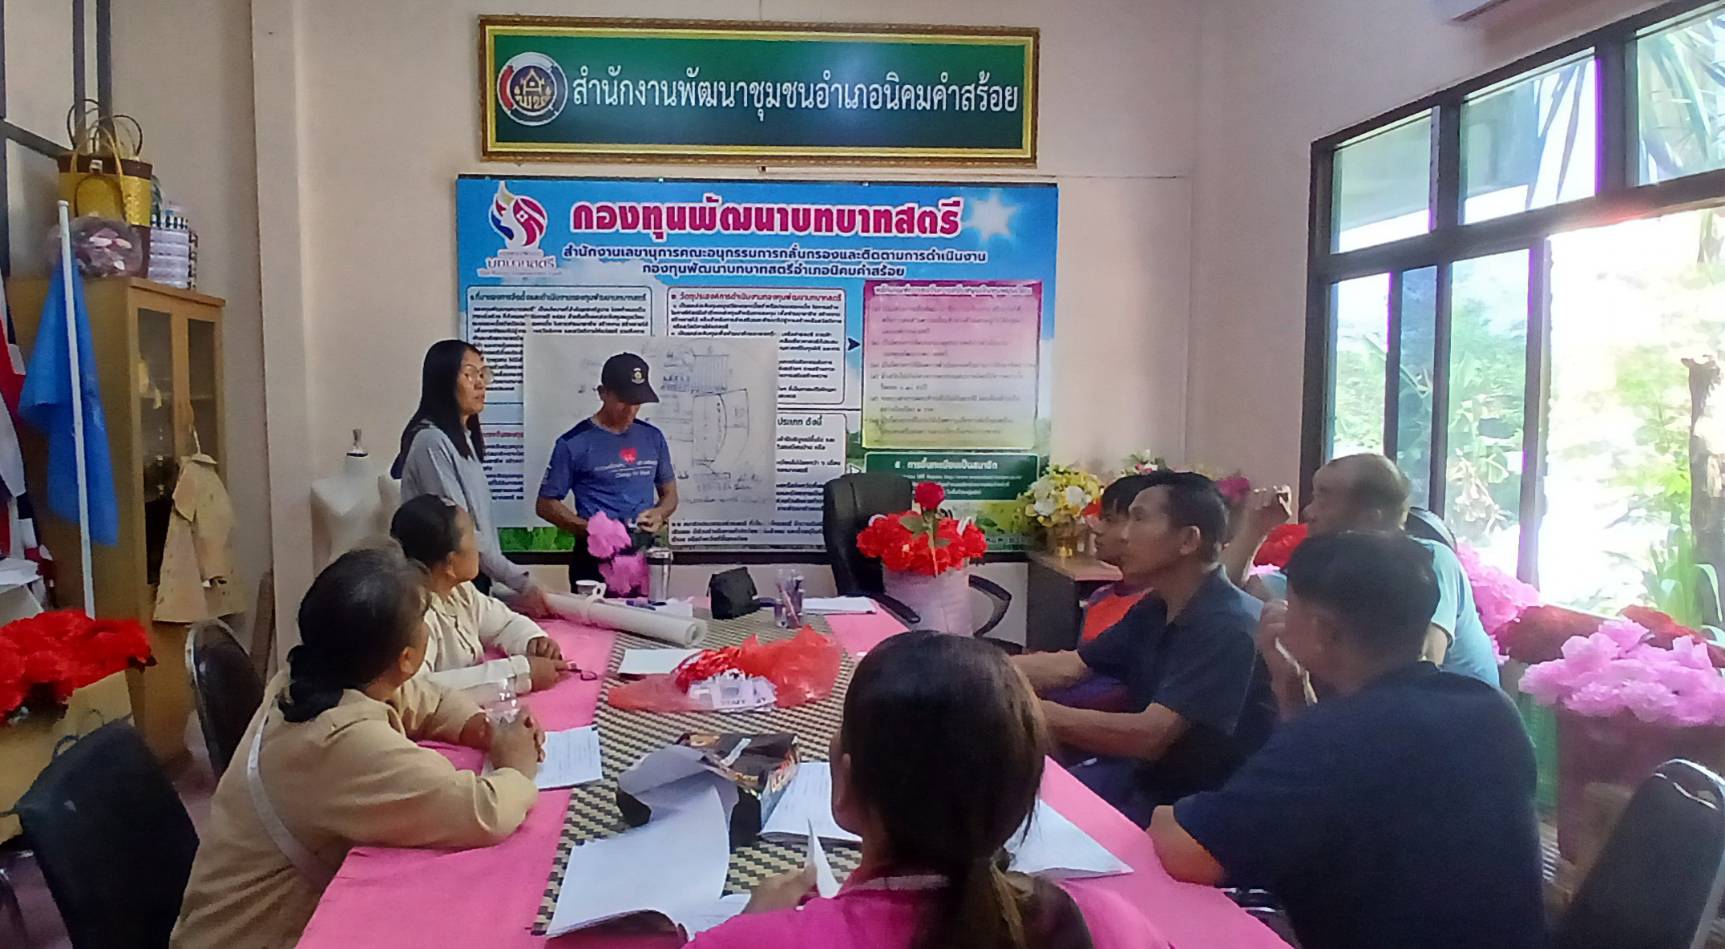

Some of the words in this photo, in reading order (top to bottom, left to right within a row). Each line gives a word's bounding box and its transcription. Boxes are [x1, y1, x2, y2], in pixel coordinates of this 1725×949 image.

[572, 65, 1019, 122] สำนักงานพัฒนาชุมชนอำเภอนิคมคำสร้อย
[572, 195, 961, 240] กองทุนพัฒนาบทบาทสตรี
[563, 244, 986, 261] สำนักงานเลขานุการคณะอนุกรรมการกลั่นกรองและติดตามการดำเนินงาน
[642, 263, 905, 277] กองทุนพัฒนาบทบาทสตรีอำเภอนิคมคำสร้อย
